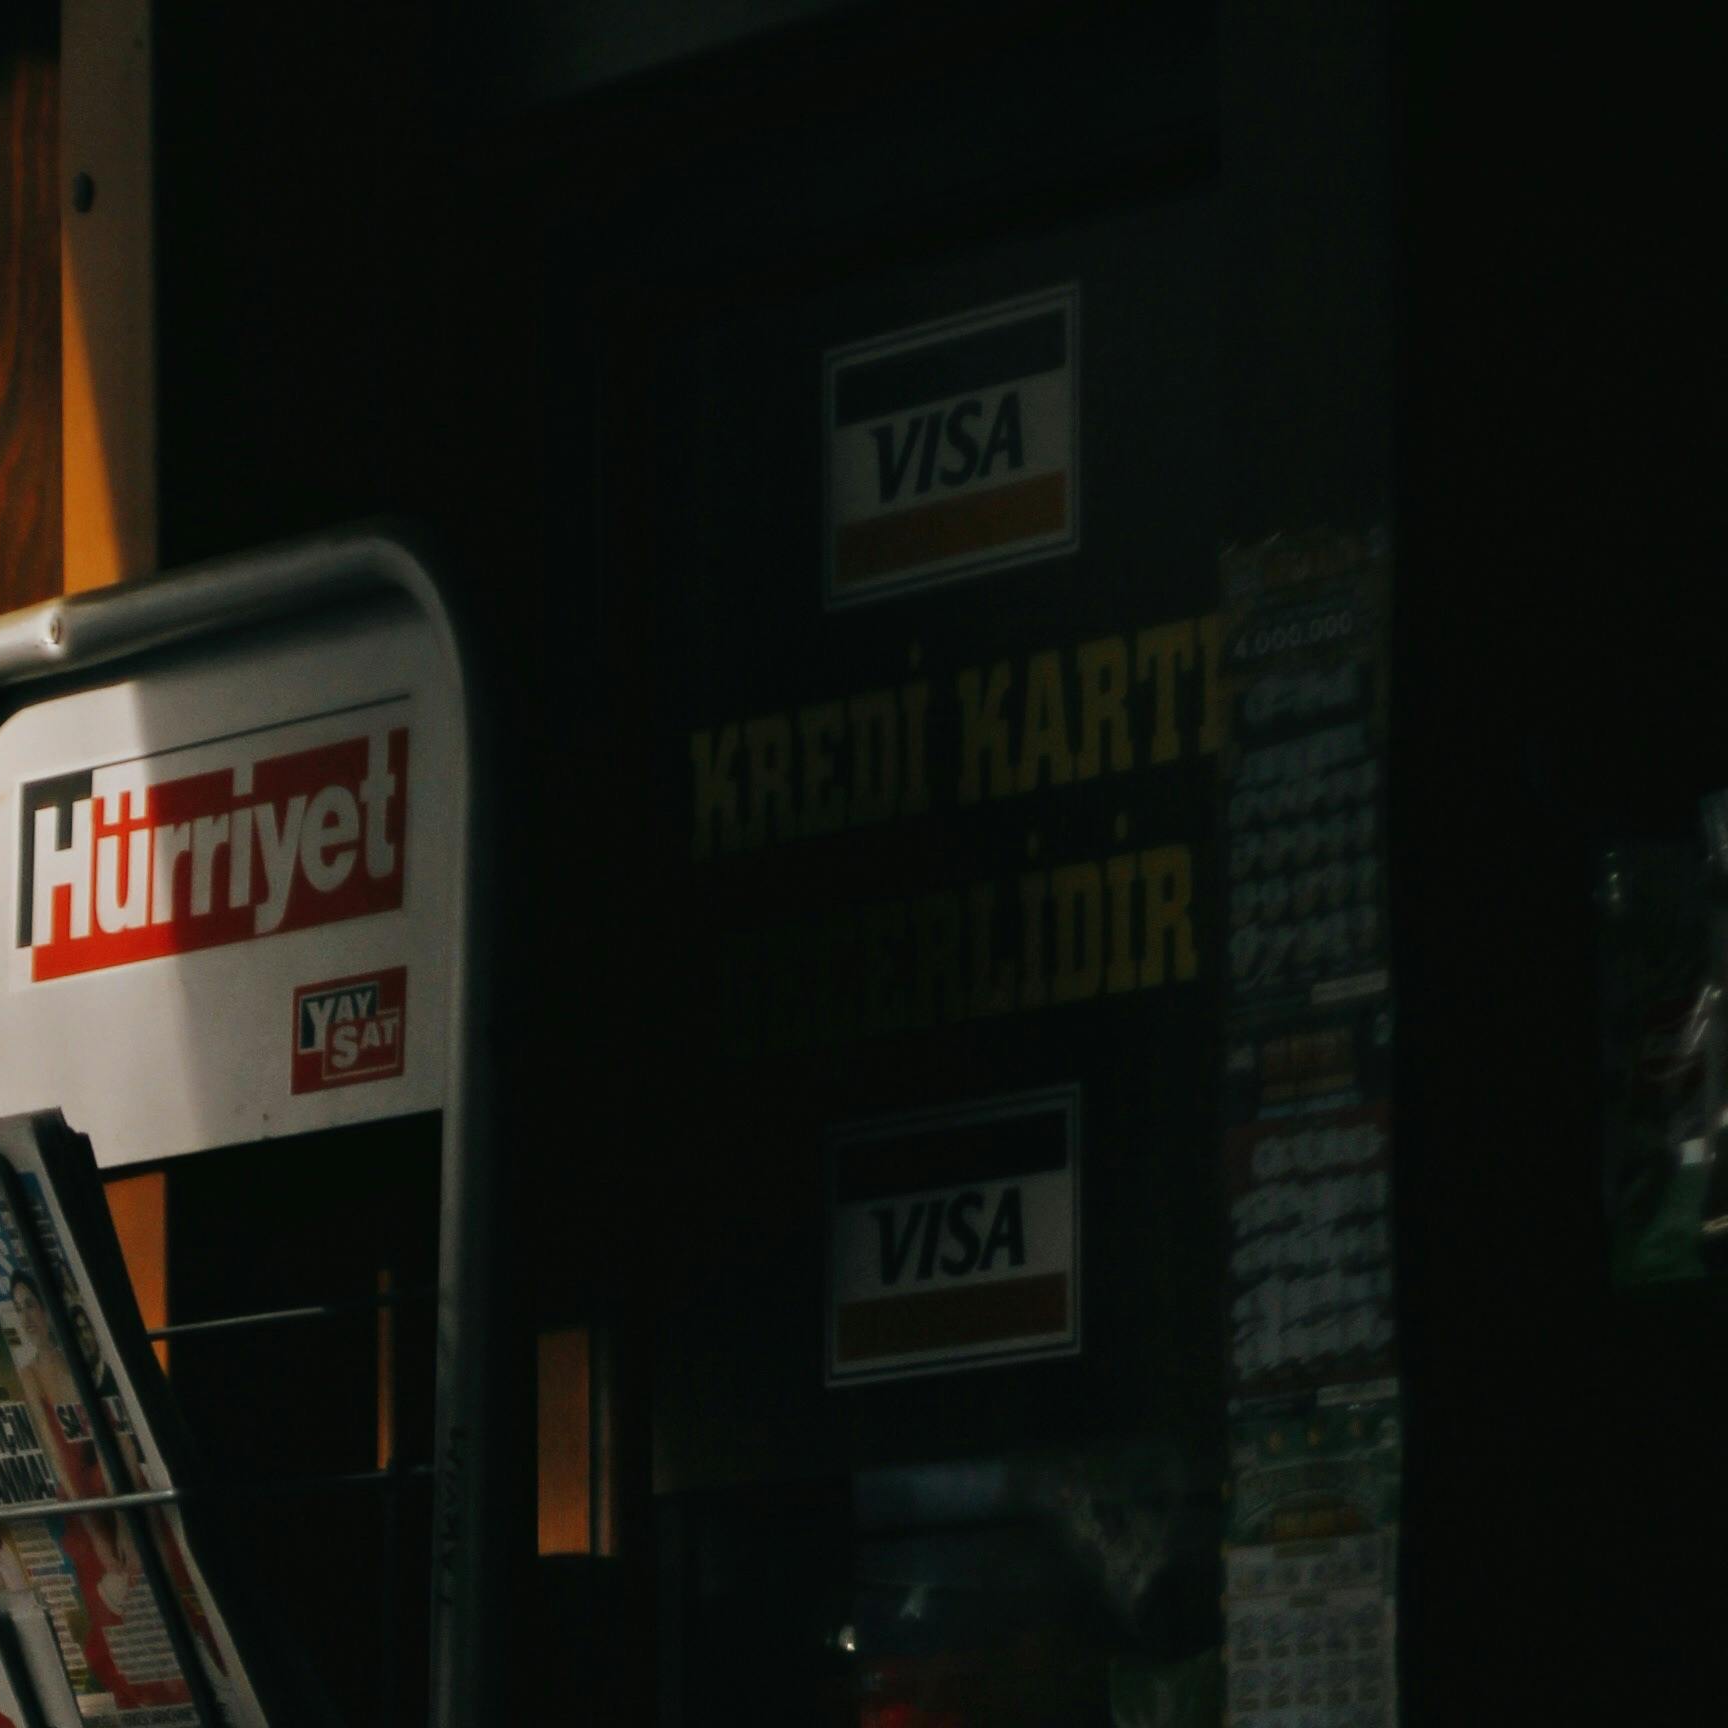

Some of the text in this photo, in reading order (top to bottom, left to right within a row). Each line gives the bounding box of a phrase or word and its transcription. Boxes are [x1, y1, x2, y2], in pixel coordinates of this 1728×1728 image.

[870, 390, 1024, 503] VISA
[689, 640, 932, 863] KREDİ
[31, 733, 400, 946] Hürriyet
[306, 988, 373, 1051] YAY
[330, 1012, 399, 1067] SAT
[873, 1184, 1024, 1284] VISA
